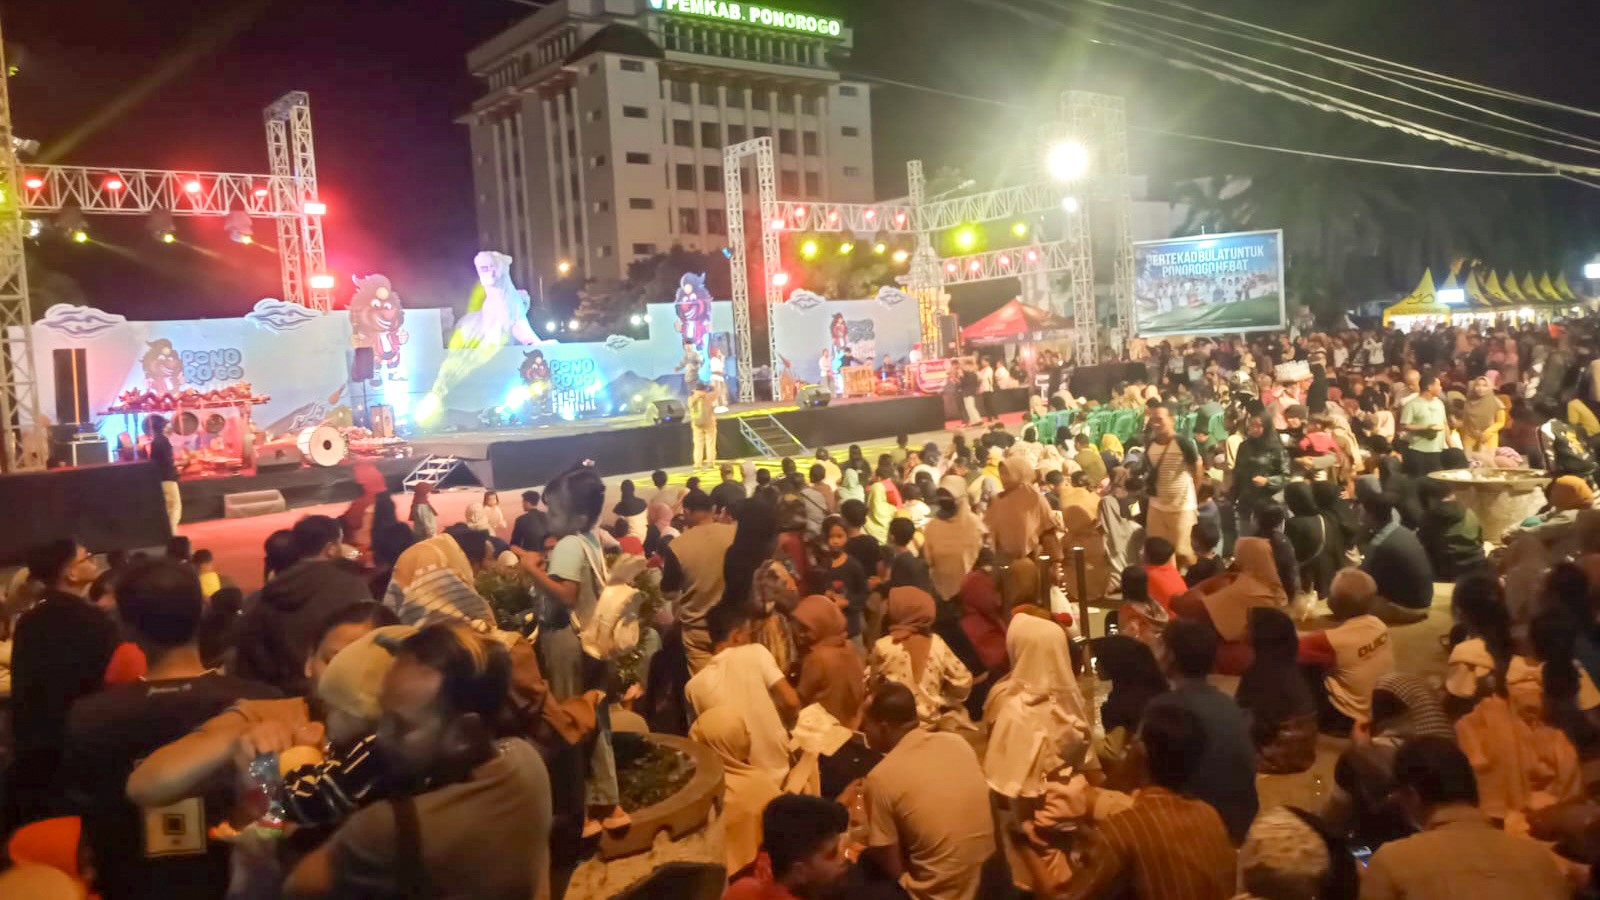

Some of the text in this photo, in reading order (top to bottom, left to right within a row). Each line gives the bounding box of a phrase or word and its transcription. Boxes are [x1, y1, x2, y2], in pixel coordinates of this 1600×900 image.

[750, 7, 841, 36] PONOROGO
[1199, 248, 1230, 262] BULAT
[1231, 246, 1264, 259] UNTUK
